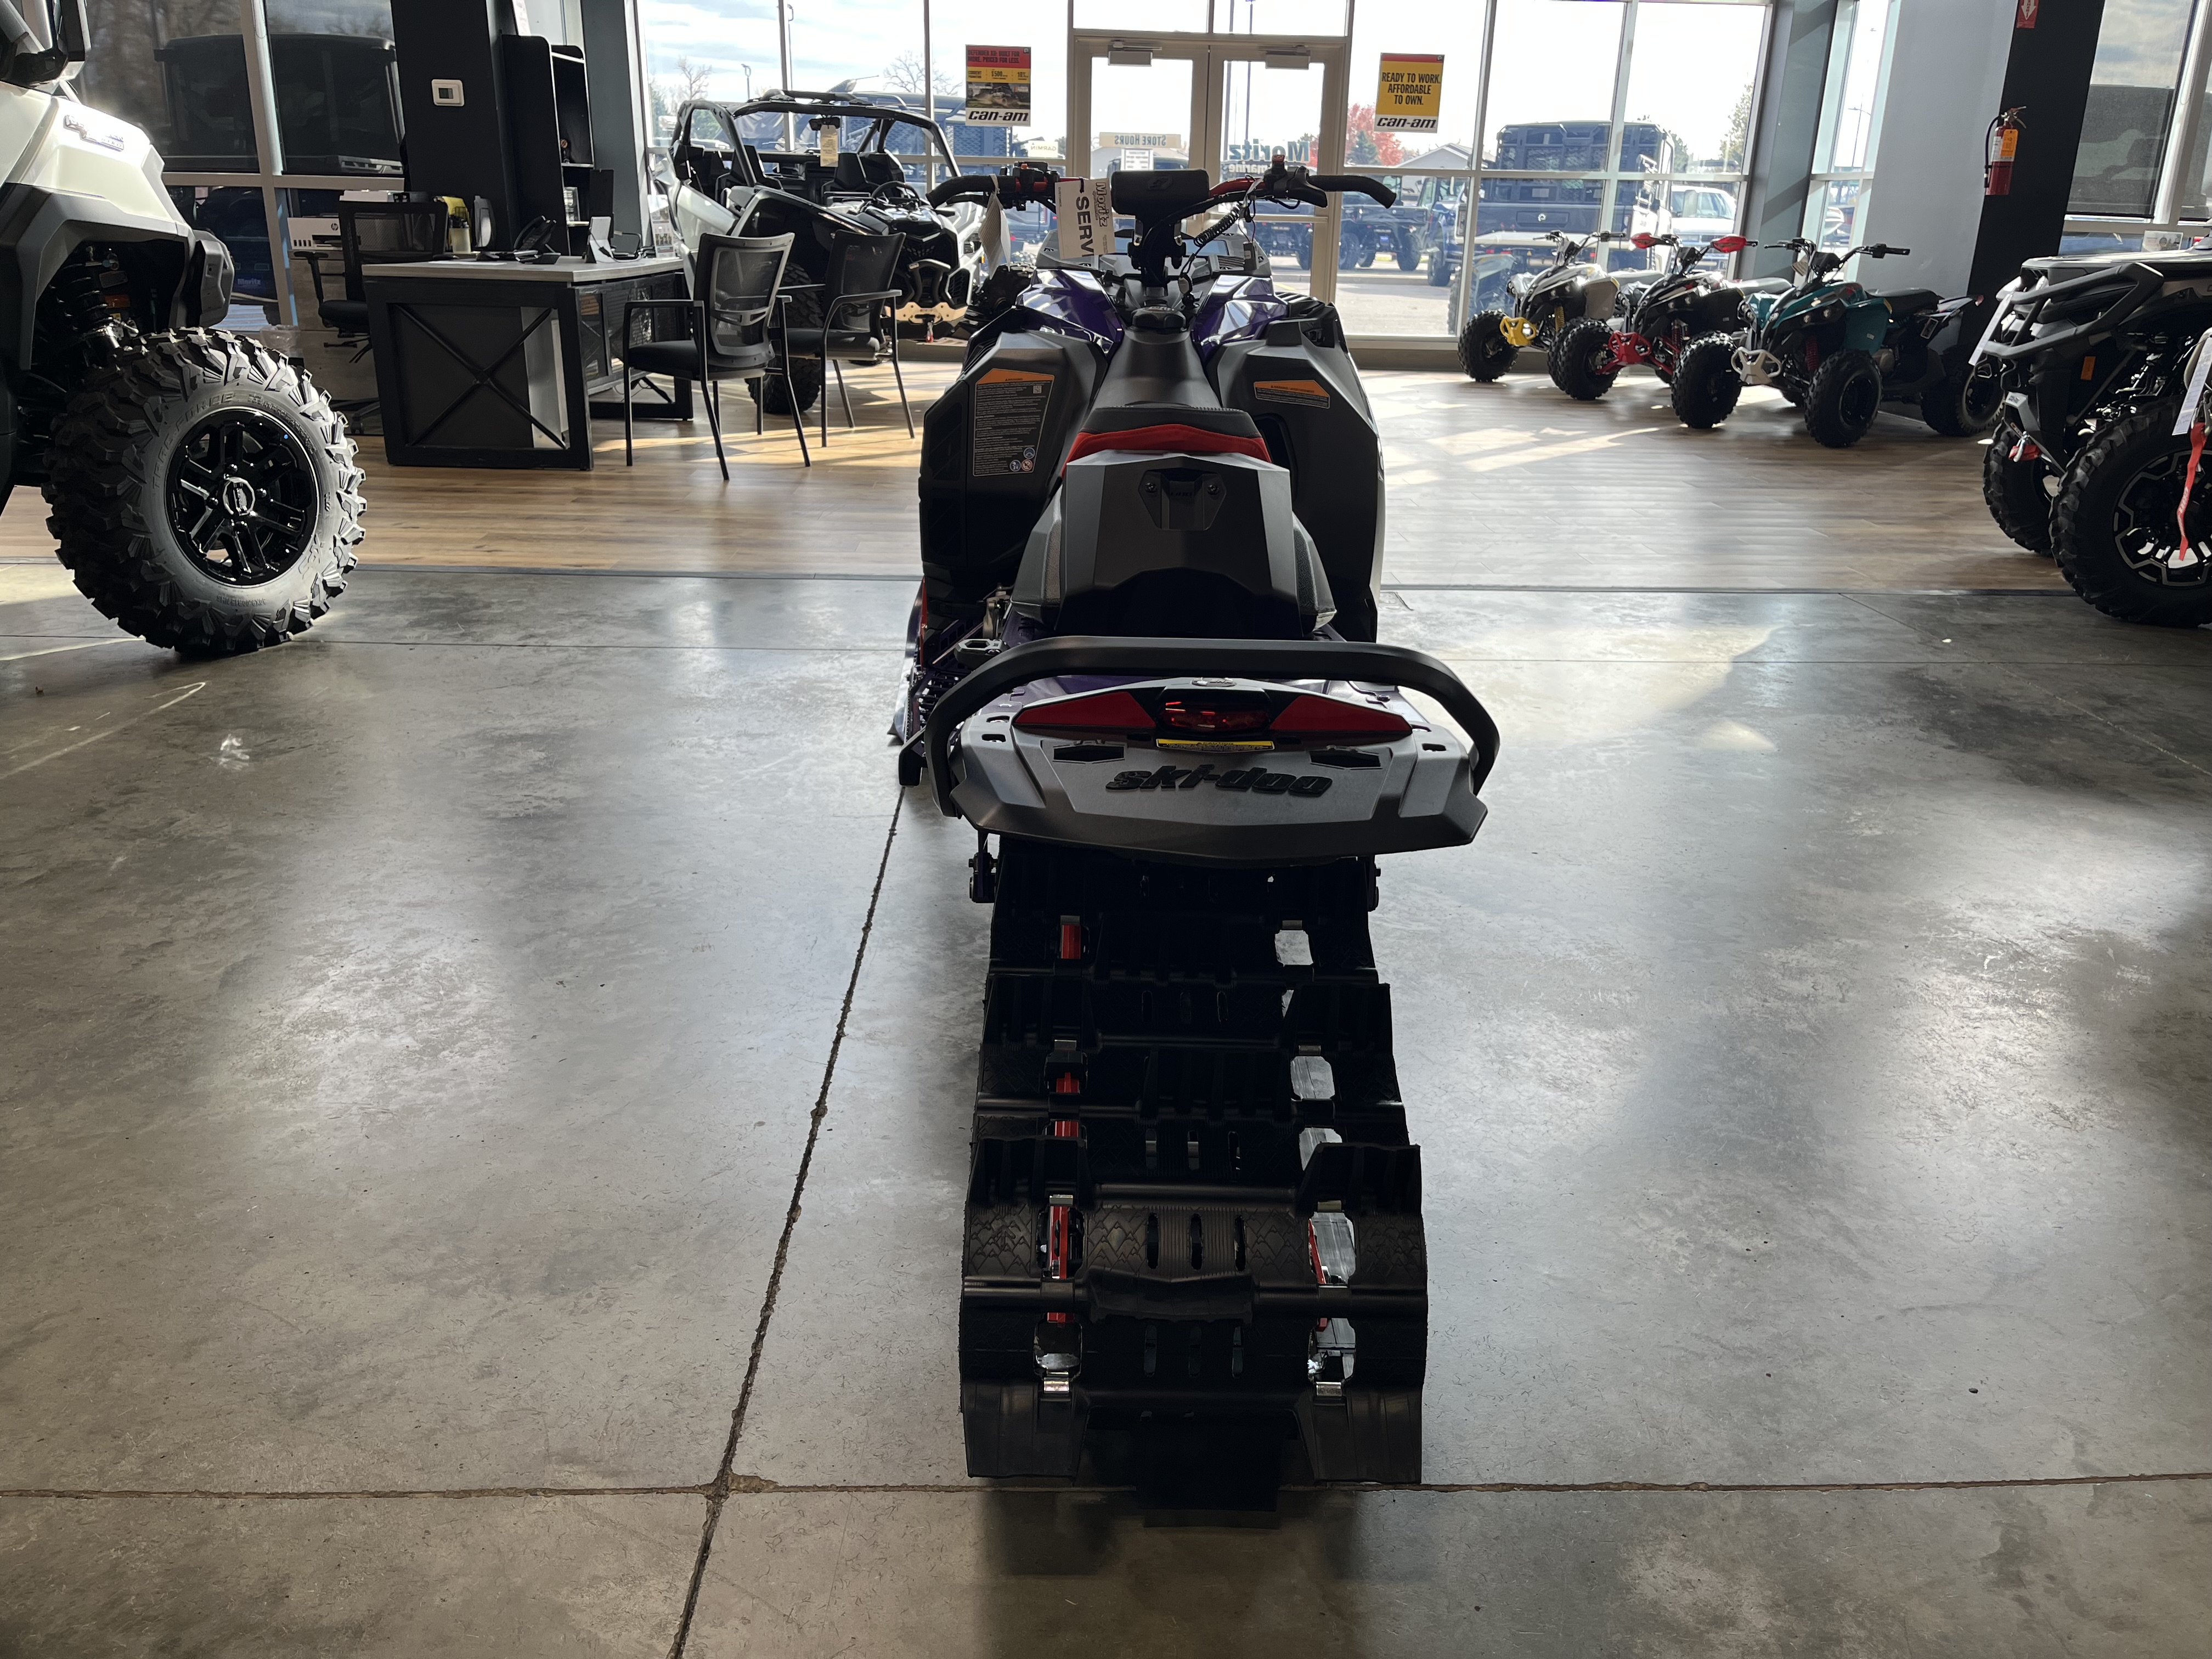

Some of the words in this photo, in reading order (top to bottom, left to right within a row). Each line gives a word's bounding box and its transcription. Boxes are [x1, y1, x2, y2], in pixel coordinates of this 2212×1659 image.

[1382, 72, 1404, 82] READY
[1407, 72, 1416, 83] TO
[1418, 74, 1441, 84] WORK.
[1387, 83, 1432, 94] AFFORDABLE
[1394, 95, 1403, 104] TO
[1406, 95, 1424, 105] OWN.
[969, 111, 1028, 122] can-am
[1377, 117, 1436, 128] can-am
[1096, 182, 1109, 227] Moritz
[237, 278, 262, 286] Moritz
[1105, 764, 1333, 797] ski-doo
